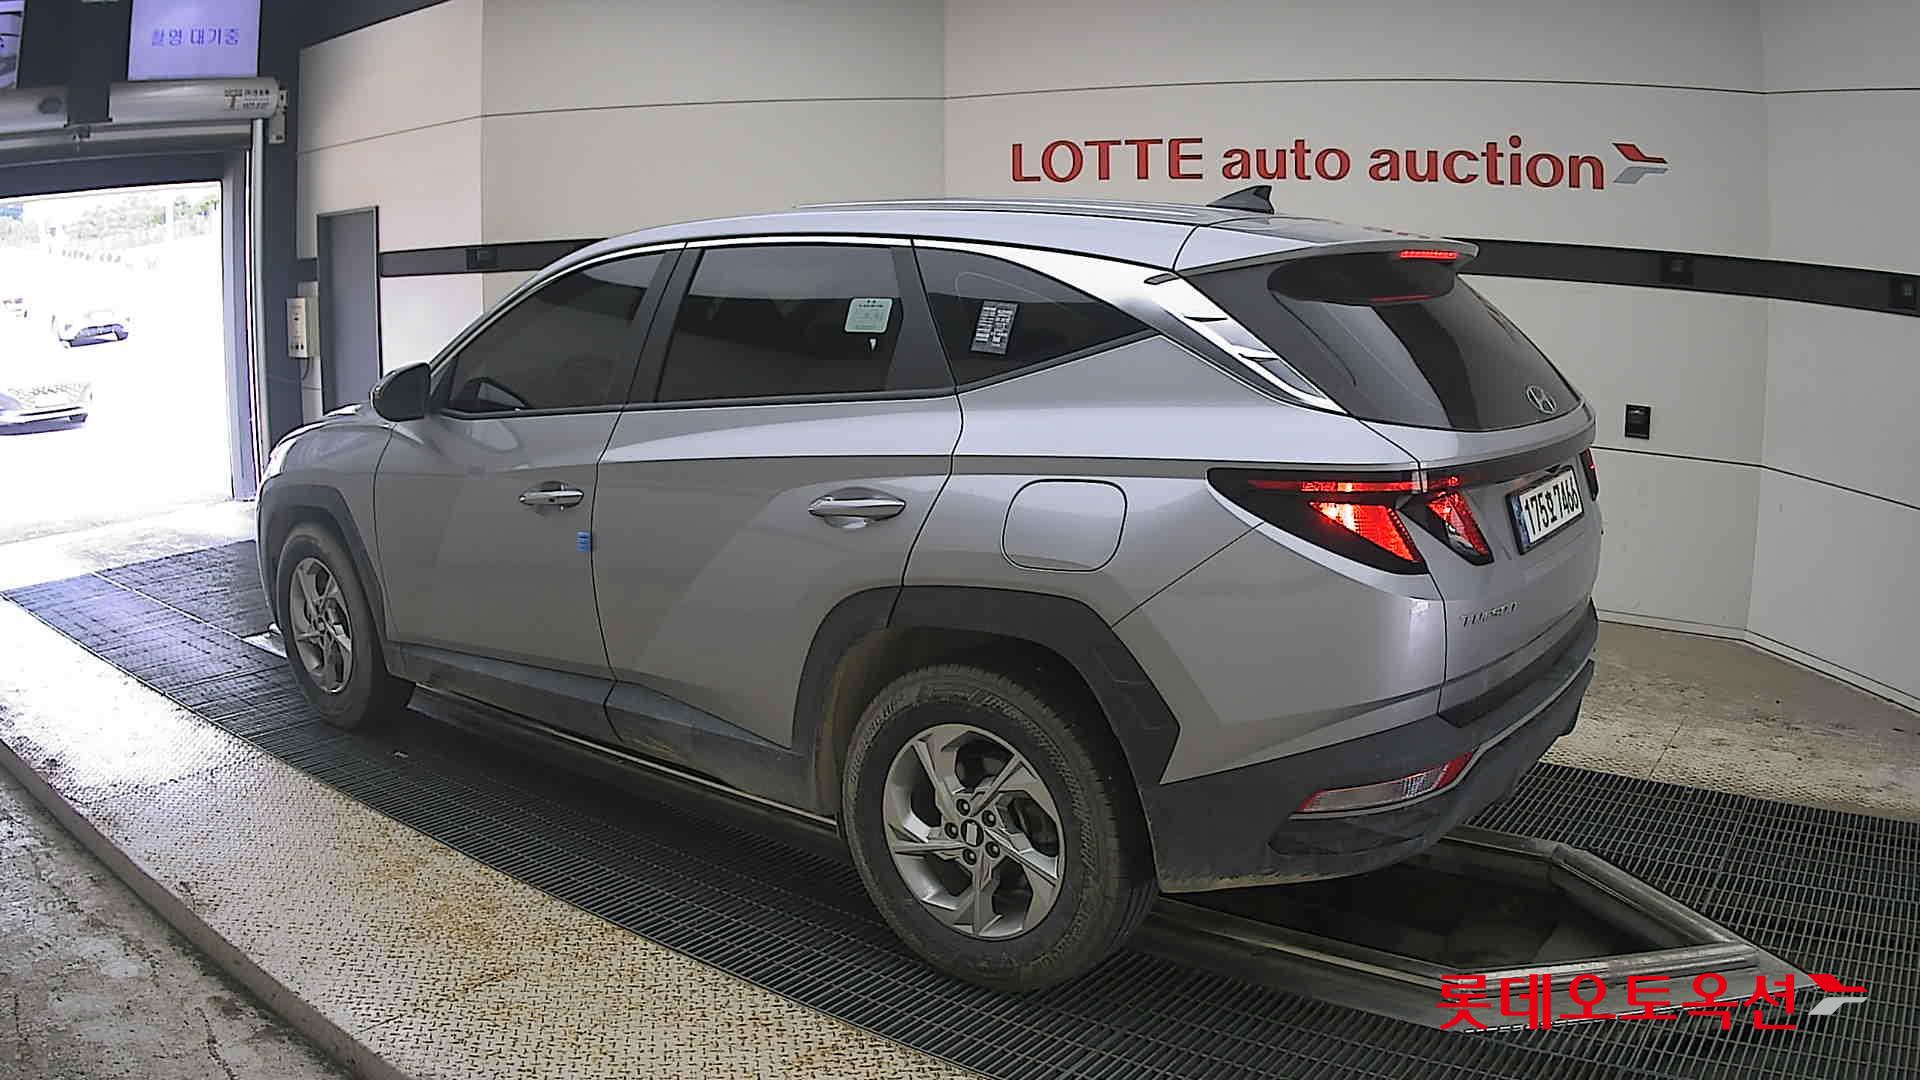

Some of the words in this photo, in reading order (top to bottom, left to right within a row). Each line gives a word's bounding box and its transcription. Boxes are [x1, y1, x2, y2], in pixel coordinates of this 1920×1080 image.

[191, 28, 239, 46] 대기중
[1012, 138, 1203, 182] LOTTE
[1222, 139, 1351, 181] auto
[1369, 135, 1604, 190] auction
